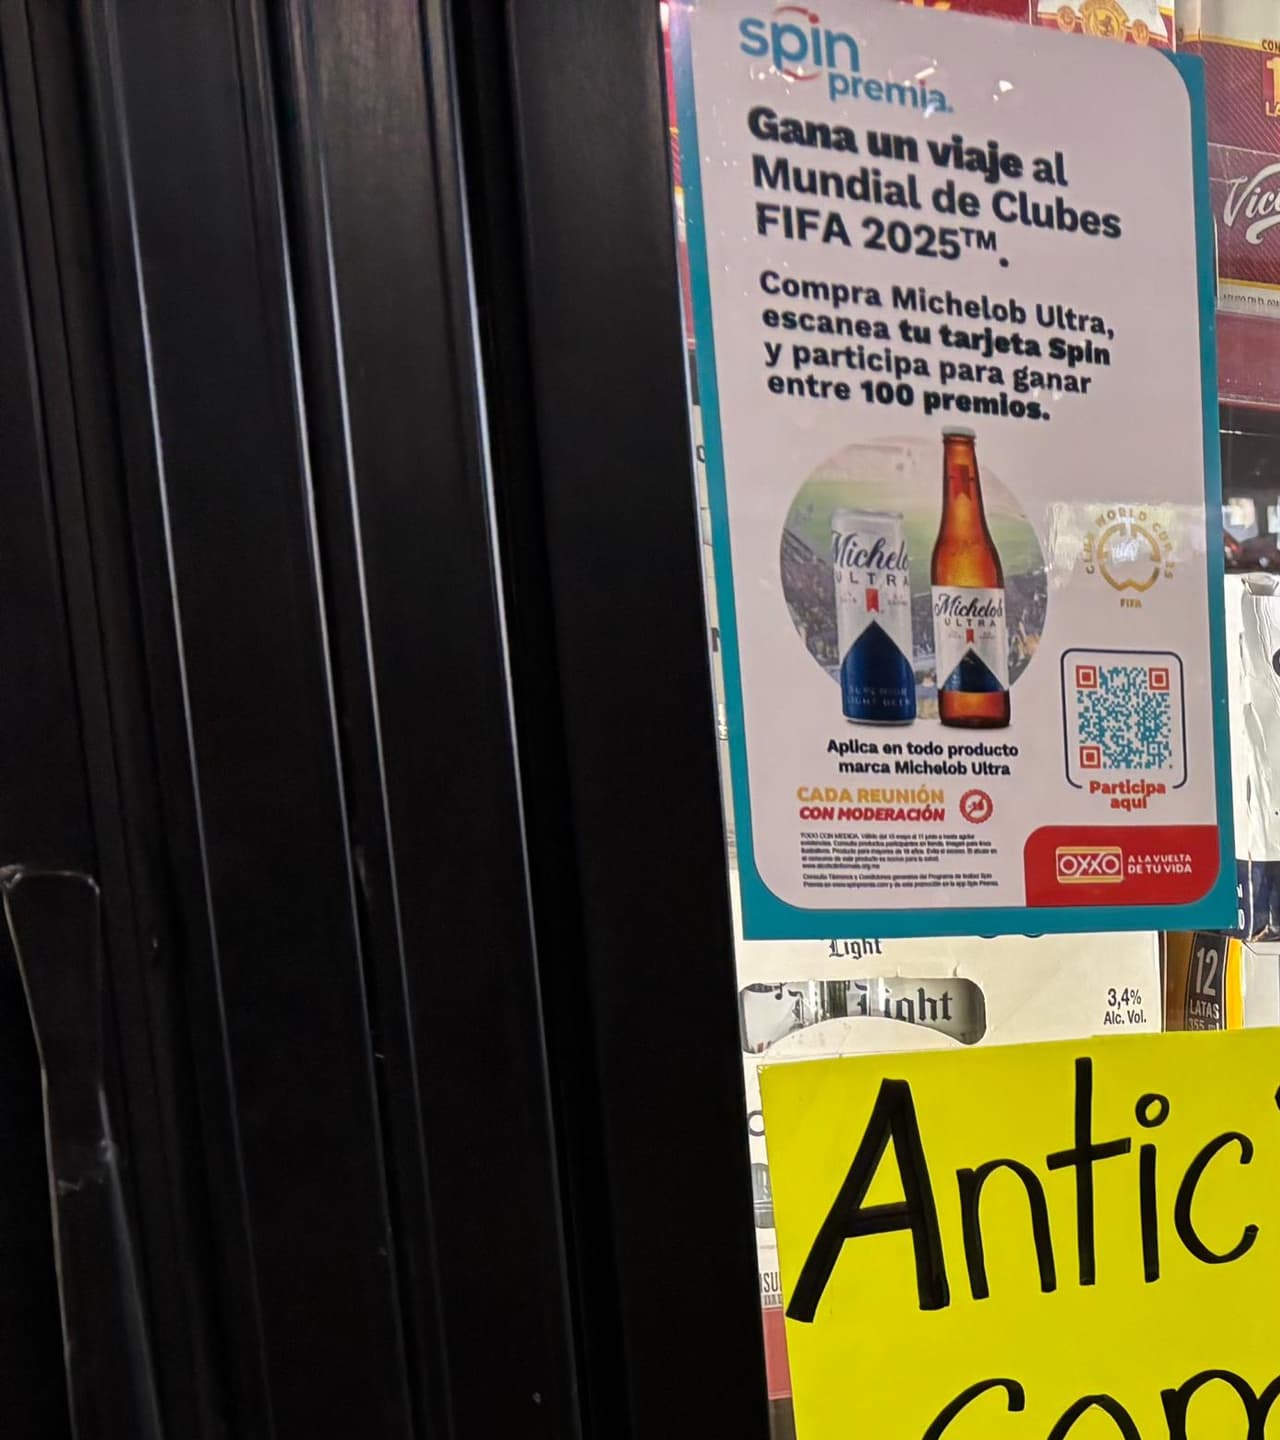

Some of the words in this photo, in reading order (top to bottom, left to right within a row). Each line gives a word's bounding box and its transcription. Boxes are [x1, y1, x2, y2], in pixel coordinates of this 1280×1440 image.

[739, 10, 861, 71] spin
[747, 106, 856, 154] Gana
[866, 128, 919, 163] un
[928, 135, 1024, 184] viaje
[1032, 152, 1068, 187] al
[752, 155, 921, 209] Mundial
[932, 181, 981, 218] de
[991, 191, 1123, 238] Clubes
[755, 203, 852, 247] FIFA
[759, 270, 881, 308] Compra
[892, 285, 1027, 324] Michelob
[1036, 304, 1115, 339] Ultra,
[761, 308, 891, 341] escanea
[898, 321, 932, 346] tu
[939, 324, 1041, 359] tarjeta
[1048, 338, 1111, 367] Spin
[764, 339, 782, 367] y
[792, 342, 930, 378] participa
[940, 357, 1004, 386] para
[1013, 365, 1091, 395] ganar
[768, 374, 851, 400] entre
[861, 382, 915, 407] 100
[923, 392, 1050, 420] premios.
[827, 739, 879, 758] Aplica
[882, 743, 903, 756] en
[907, 741, 943, 757] todo
[948, 742, 1019, 760] producto
[838, 761, 892, 775] marca
[894, 760, 968, 776] Michelob
[971, 760, 1011, 776] Ultra
[796, 787, 852, 803] CADA
[857, 784, 944, 805] REUNIÓN
[1089, 780, 1166, 797] Participa
[800, 806, 834, 821] CON
[837, 803, 945, 823] MODERACIÓN
[1110, 795, 1148, 811] aquí
[1059, 852, 1121, 876] OXXO
[1128, 864, 1143, 873] DE
[1145, 864, 1159, 873] TU
[1162, 864, 1193, 874] VIDA
[1151, 854, 1193, 864] VUELTA
[1196, 947, 1218, 997] 12
[1107, 987, 1142, 1008] 3,4%
[1103, 1011, 1126, 1025] Alc.
[1127, 1010, 1147, 1024] Vol.
[1189, 1000, 1220, 1019] LATAS
